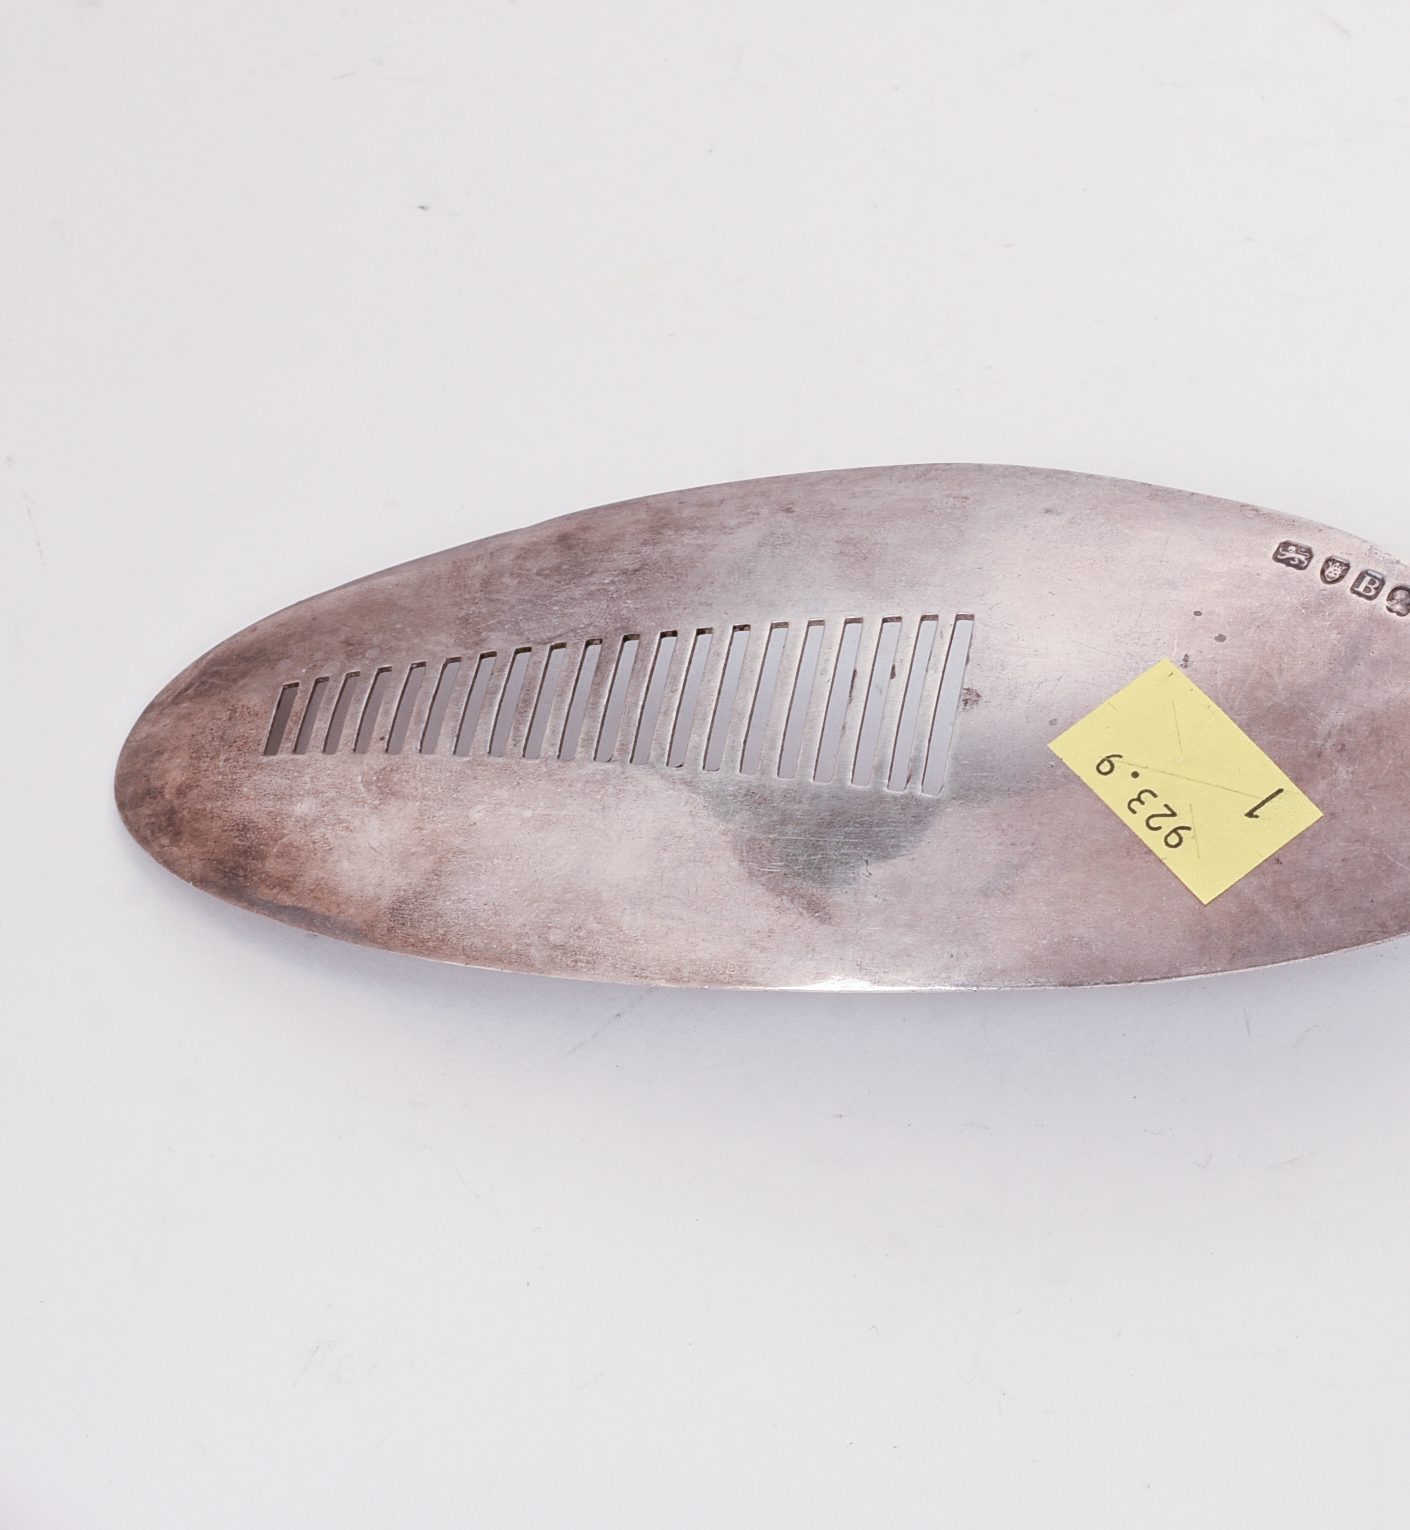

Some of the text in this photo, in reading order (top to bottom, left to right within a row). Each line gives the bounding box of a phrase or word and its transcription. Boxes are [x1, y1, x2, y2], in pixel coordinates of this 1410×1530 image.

[1359, 575, 1380, 597] B
[1096, 753, 1192, 849] 923.9
[1244, 787, 1285, 819] 1
